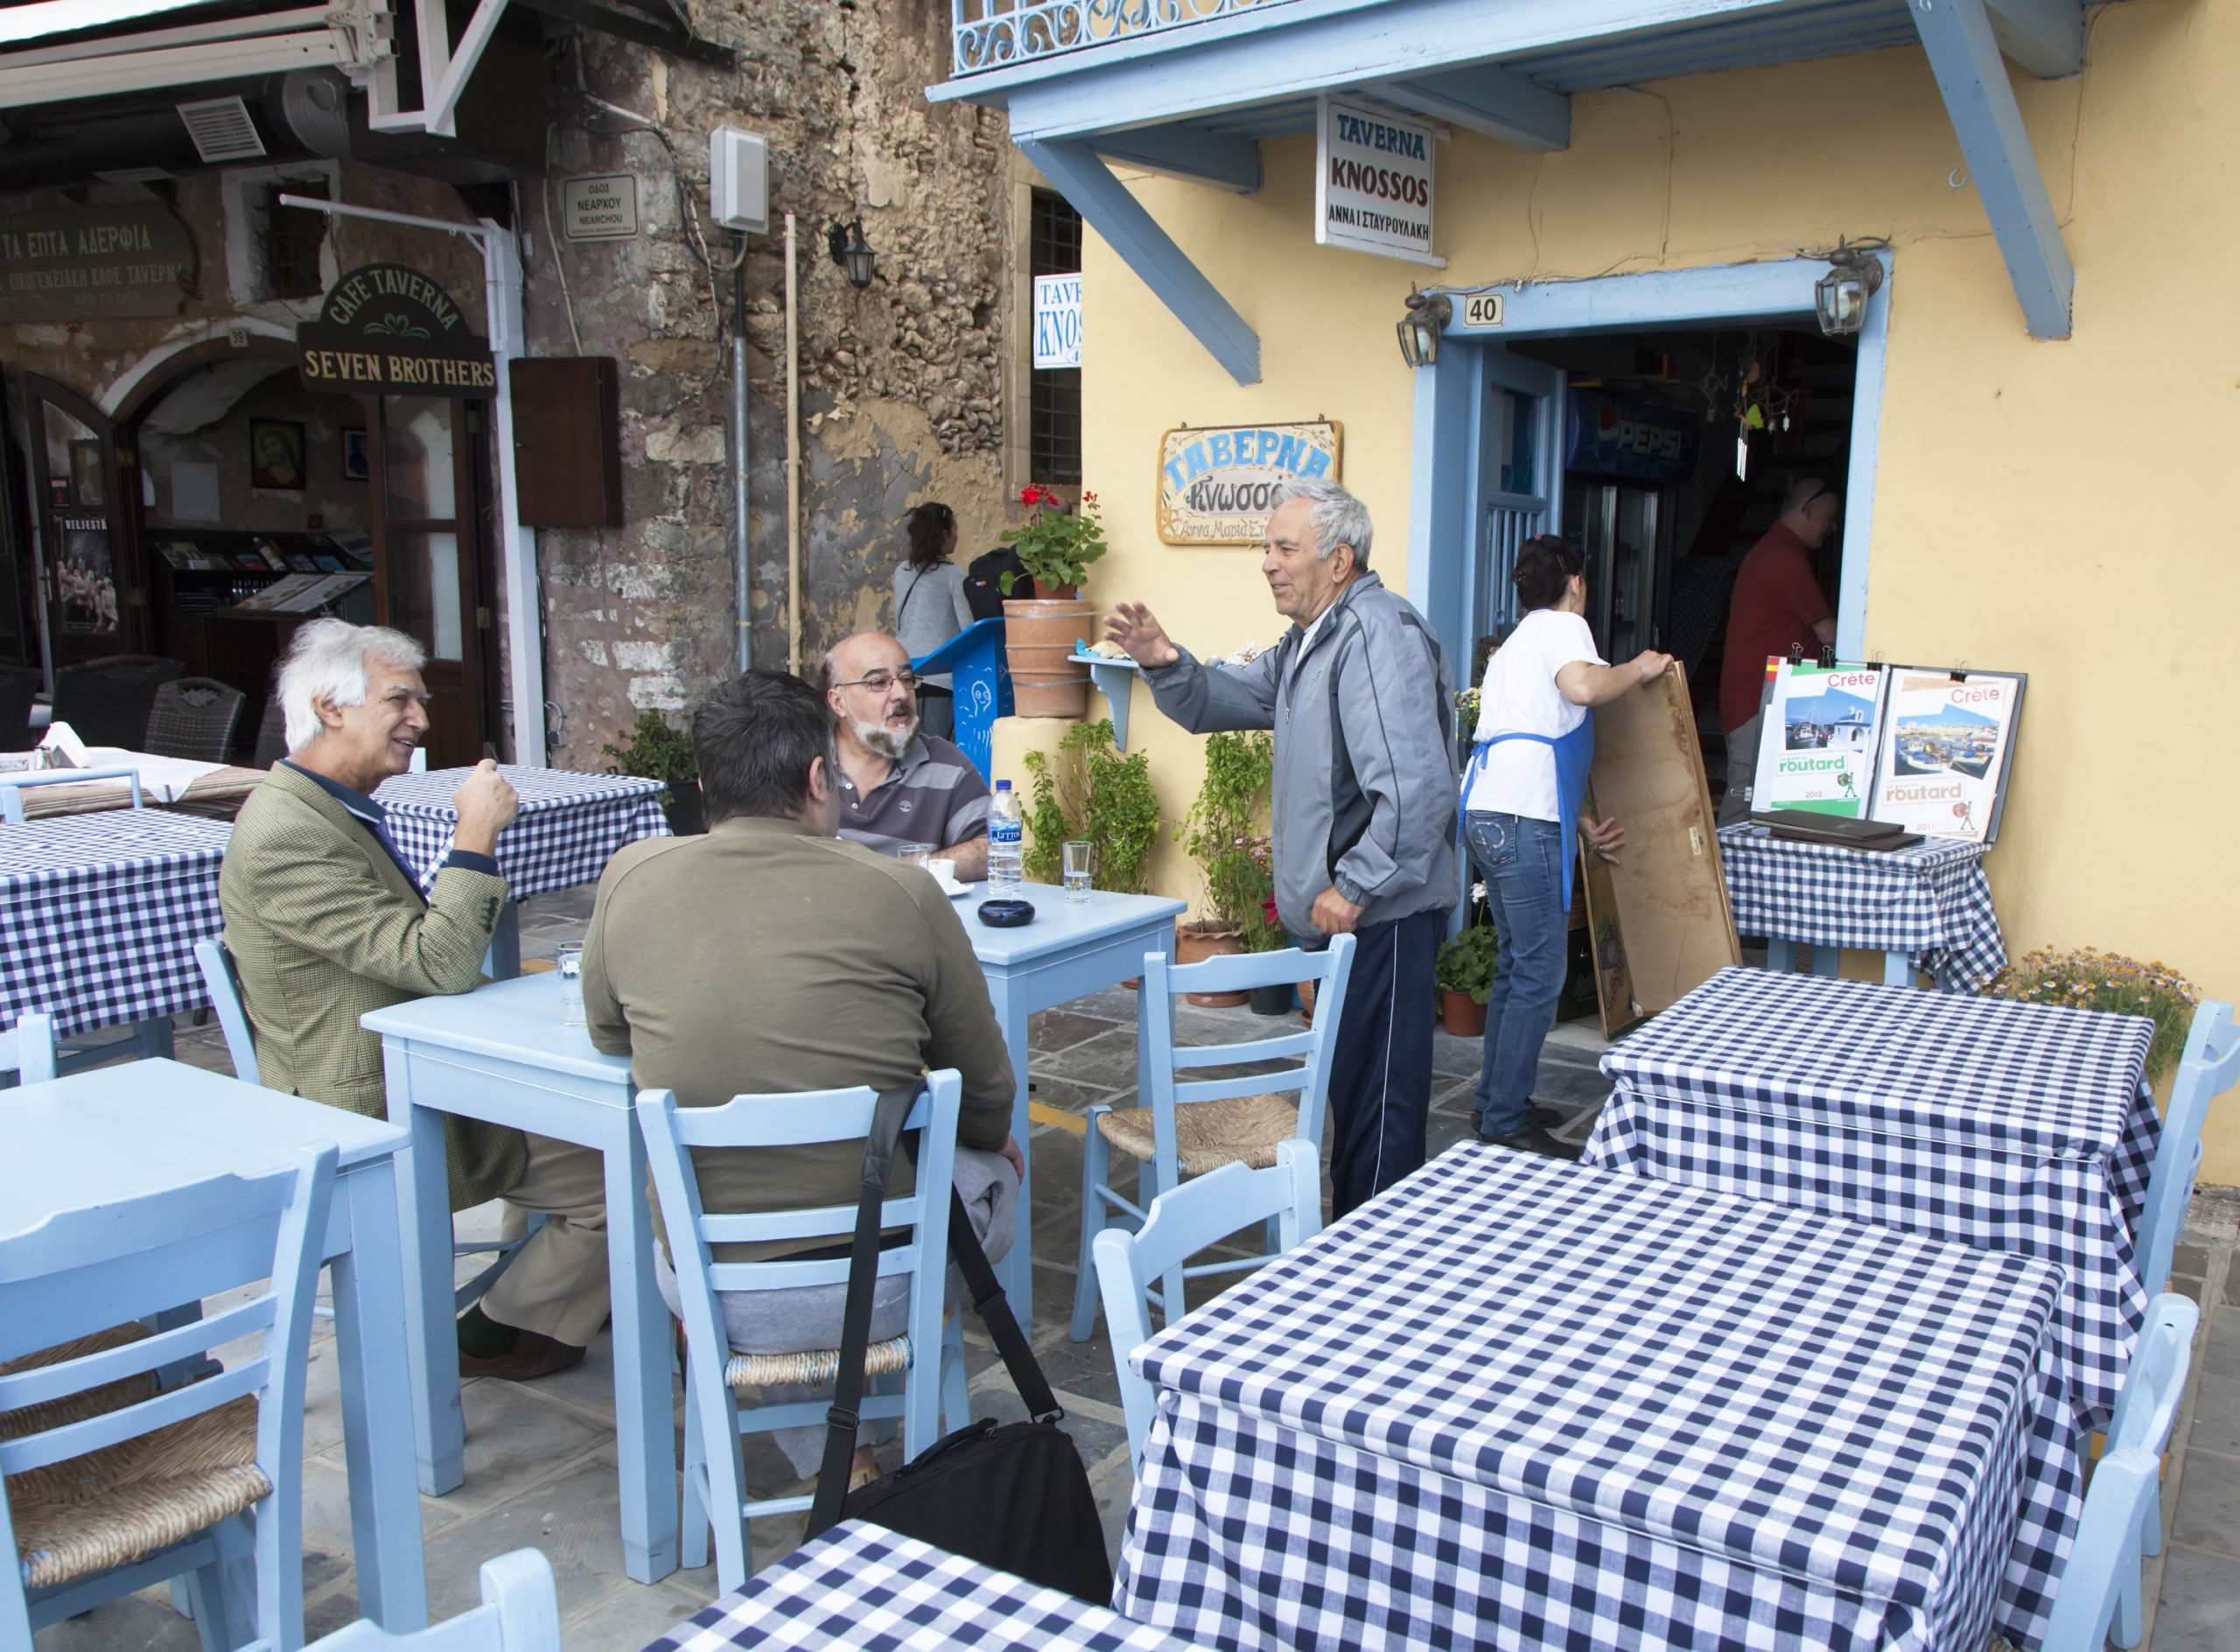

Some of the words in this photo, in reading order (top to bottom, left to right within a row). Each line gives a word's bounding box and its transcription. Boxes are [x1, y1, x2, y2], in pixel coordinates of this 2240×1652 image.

[1337, 113, 1425, 161] TAVERNA
[588, 183, 610, 194] ΟΔΟΣ
[1332, 156, 1429, 207] KNOSSOS
[578, 196, 621, 212] ΝΕΑΡΧΟΥ
[1328, 203, 1355, 227] ΑΝΝΑ
[579, 214, 622, 225] NEARCHOU
[2, 234, 23, 260] ΤΑ
[27, 229, 70, 258] ΕΠΤΑ
[78, 223, 153, 256] ΑΔΕΡΦΙΑ
[329, 274, 374, 325] CAFE
[368, 268, 460, 331] TAVERNA
[1469, 298, 1496, 321] 40
[232, 330, 244, 343] 39
[1039, 308, 1082, 356] KNO
[304, 349, 383, 382] SEVEN
[387, 355, 495, 388] BROTHERS
[1616, 419, 1682, 459] PEPSI
[1164, 429, 1332, 495] ΤΑΒΕΡΝΑ
[1827, 673, 1876, 688] Crète
[1950, 686, 2000, 704] Crète
[1778, 754, 1845, 773] routard
[1886, 781, 1962, 802] routard
